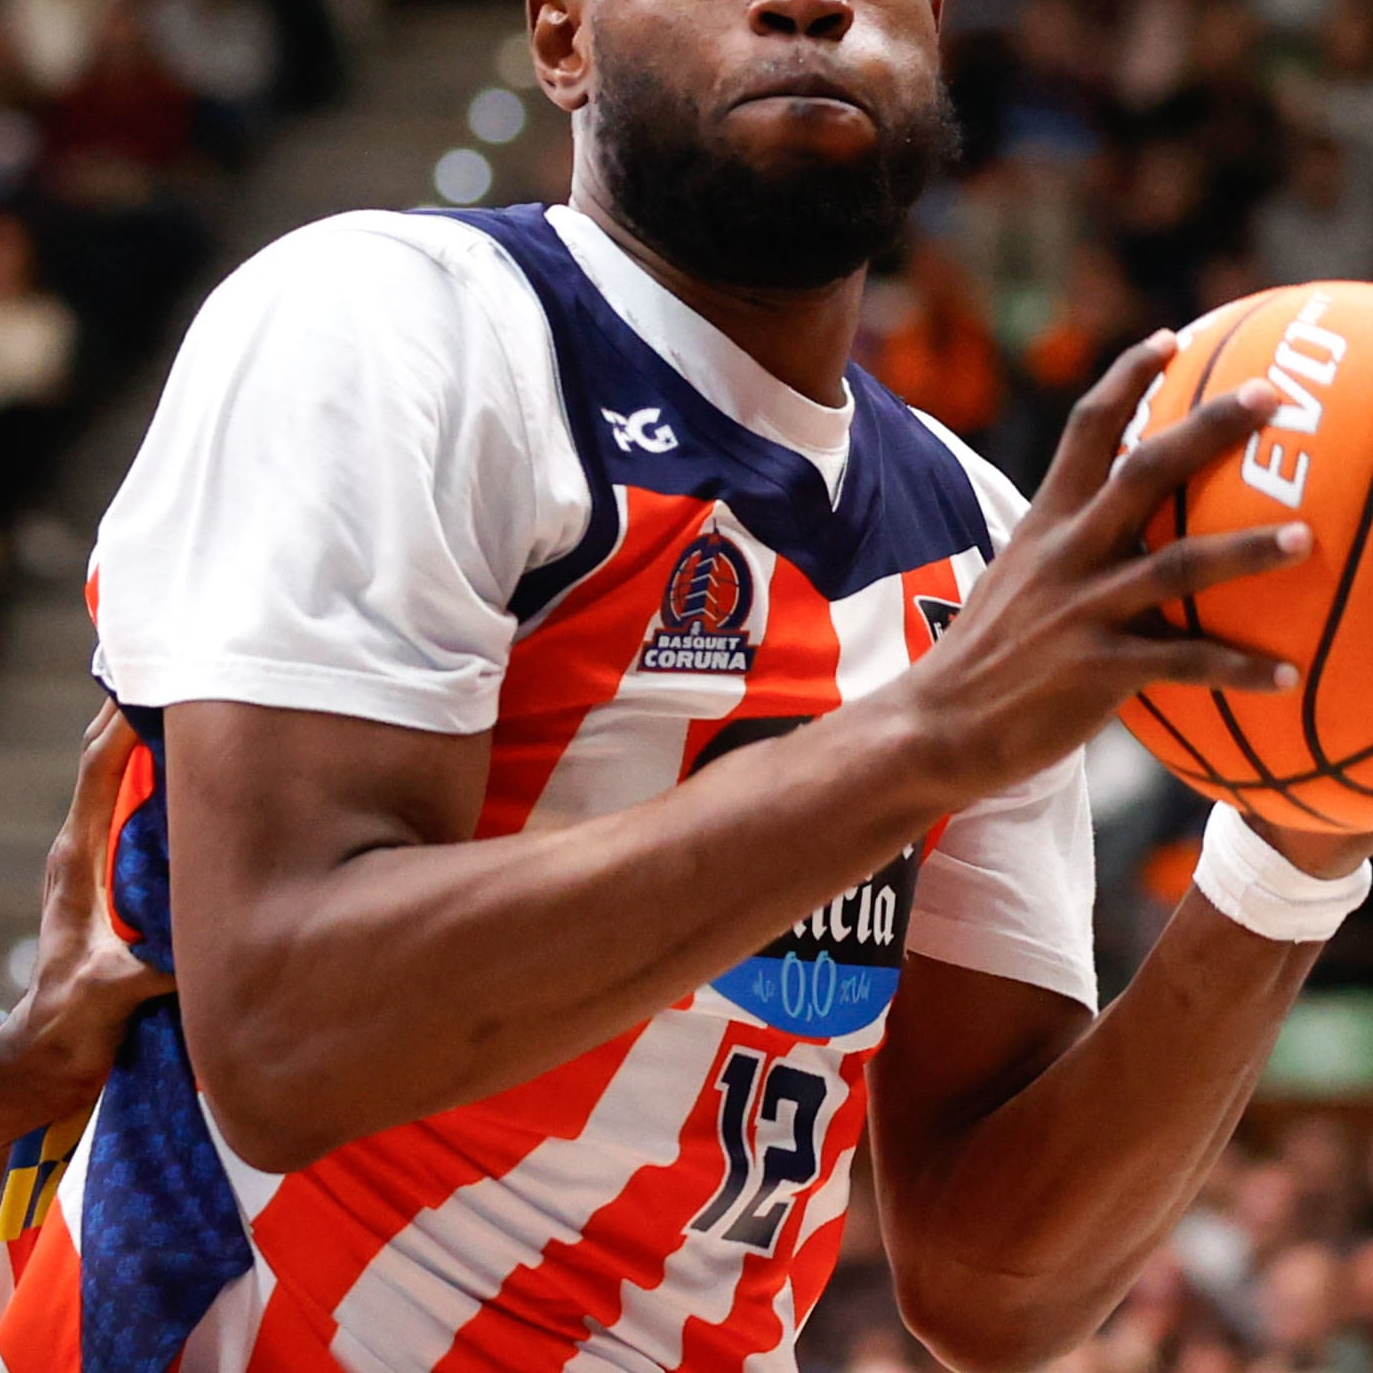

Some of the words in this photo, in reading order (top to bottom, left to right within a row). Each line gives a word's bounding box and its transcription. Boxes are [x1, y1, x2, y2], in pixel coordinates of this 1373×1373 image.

[1241, 320, 1347, 509] EVO
[658, 635, 741, 650] BASQUET
[781, 950, 837, 1022] 0,0
[681, 1045, 828, 1259] 12
